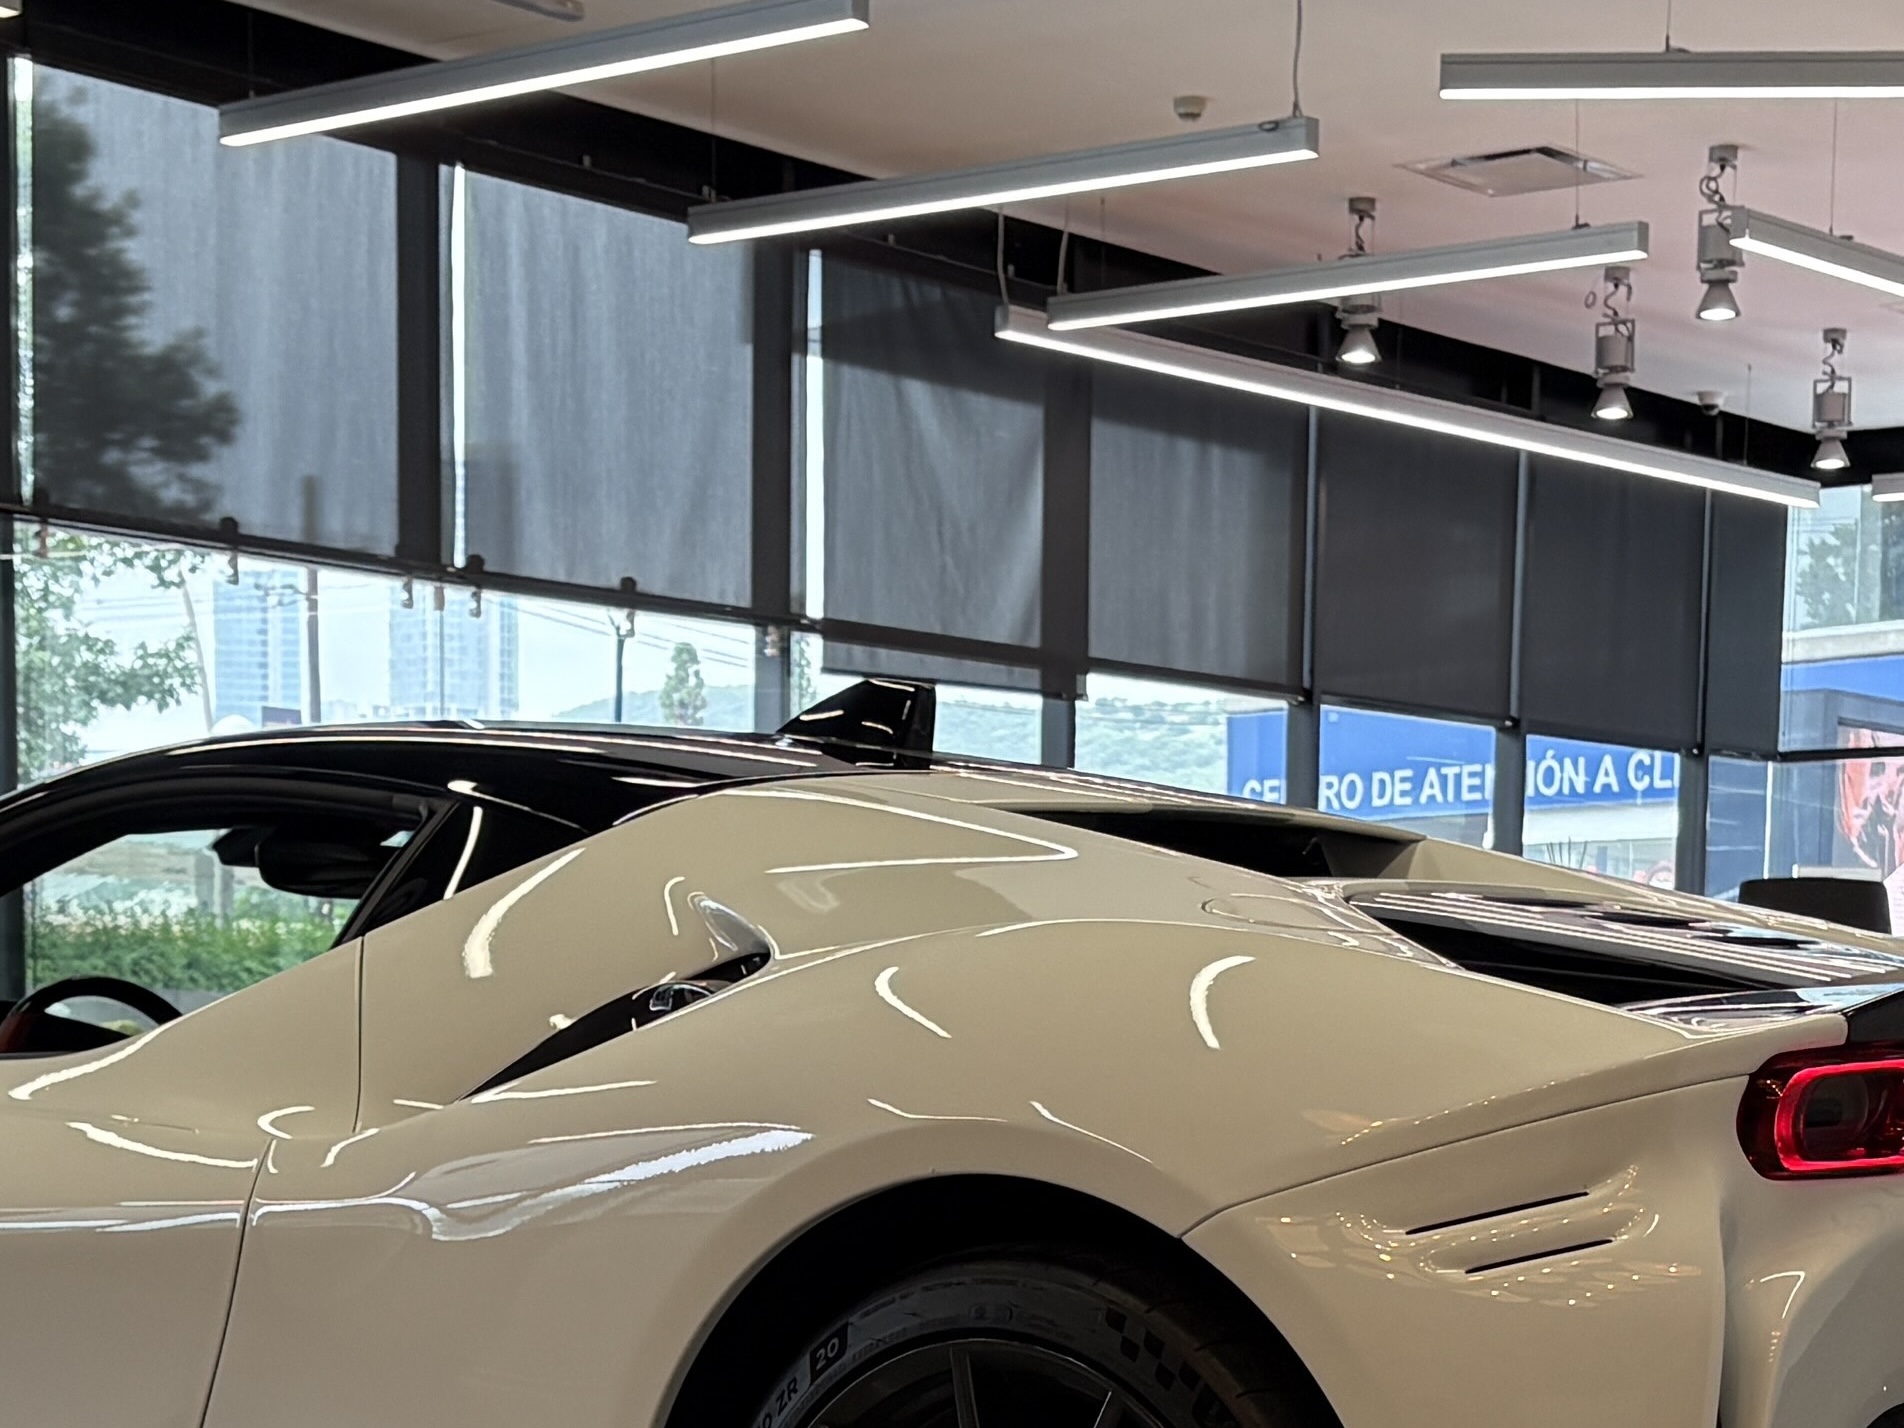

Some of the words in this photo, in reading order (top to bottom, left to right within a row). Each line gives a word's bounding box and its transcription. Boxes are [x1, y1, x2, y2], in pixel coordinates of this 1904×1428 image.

[1242, 775, 1363, 811] CERO
[1371, 769, 1413, 808] DE
[1593, 754, 1620, 793] A
[777, 1376, 800, 1418] ZR
[814, 1335, 842, 1372] 20
